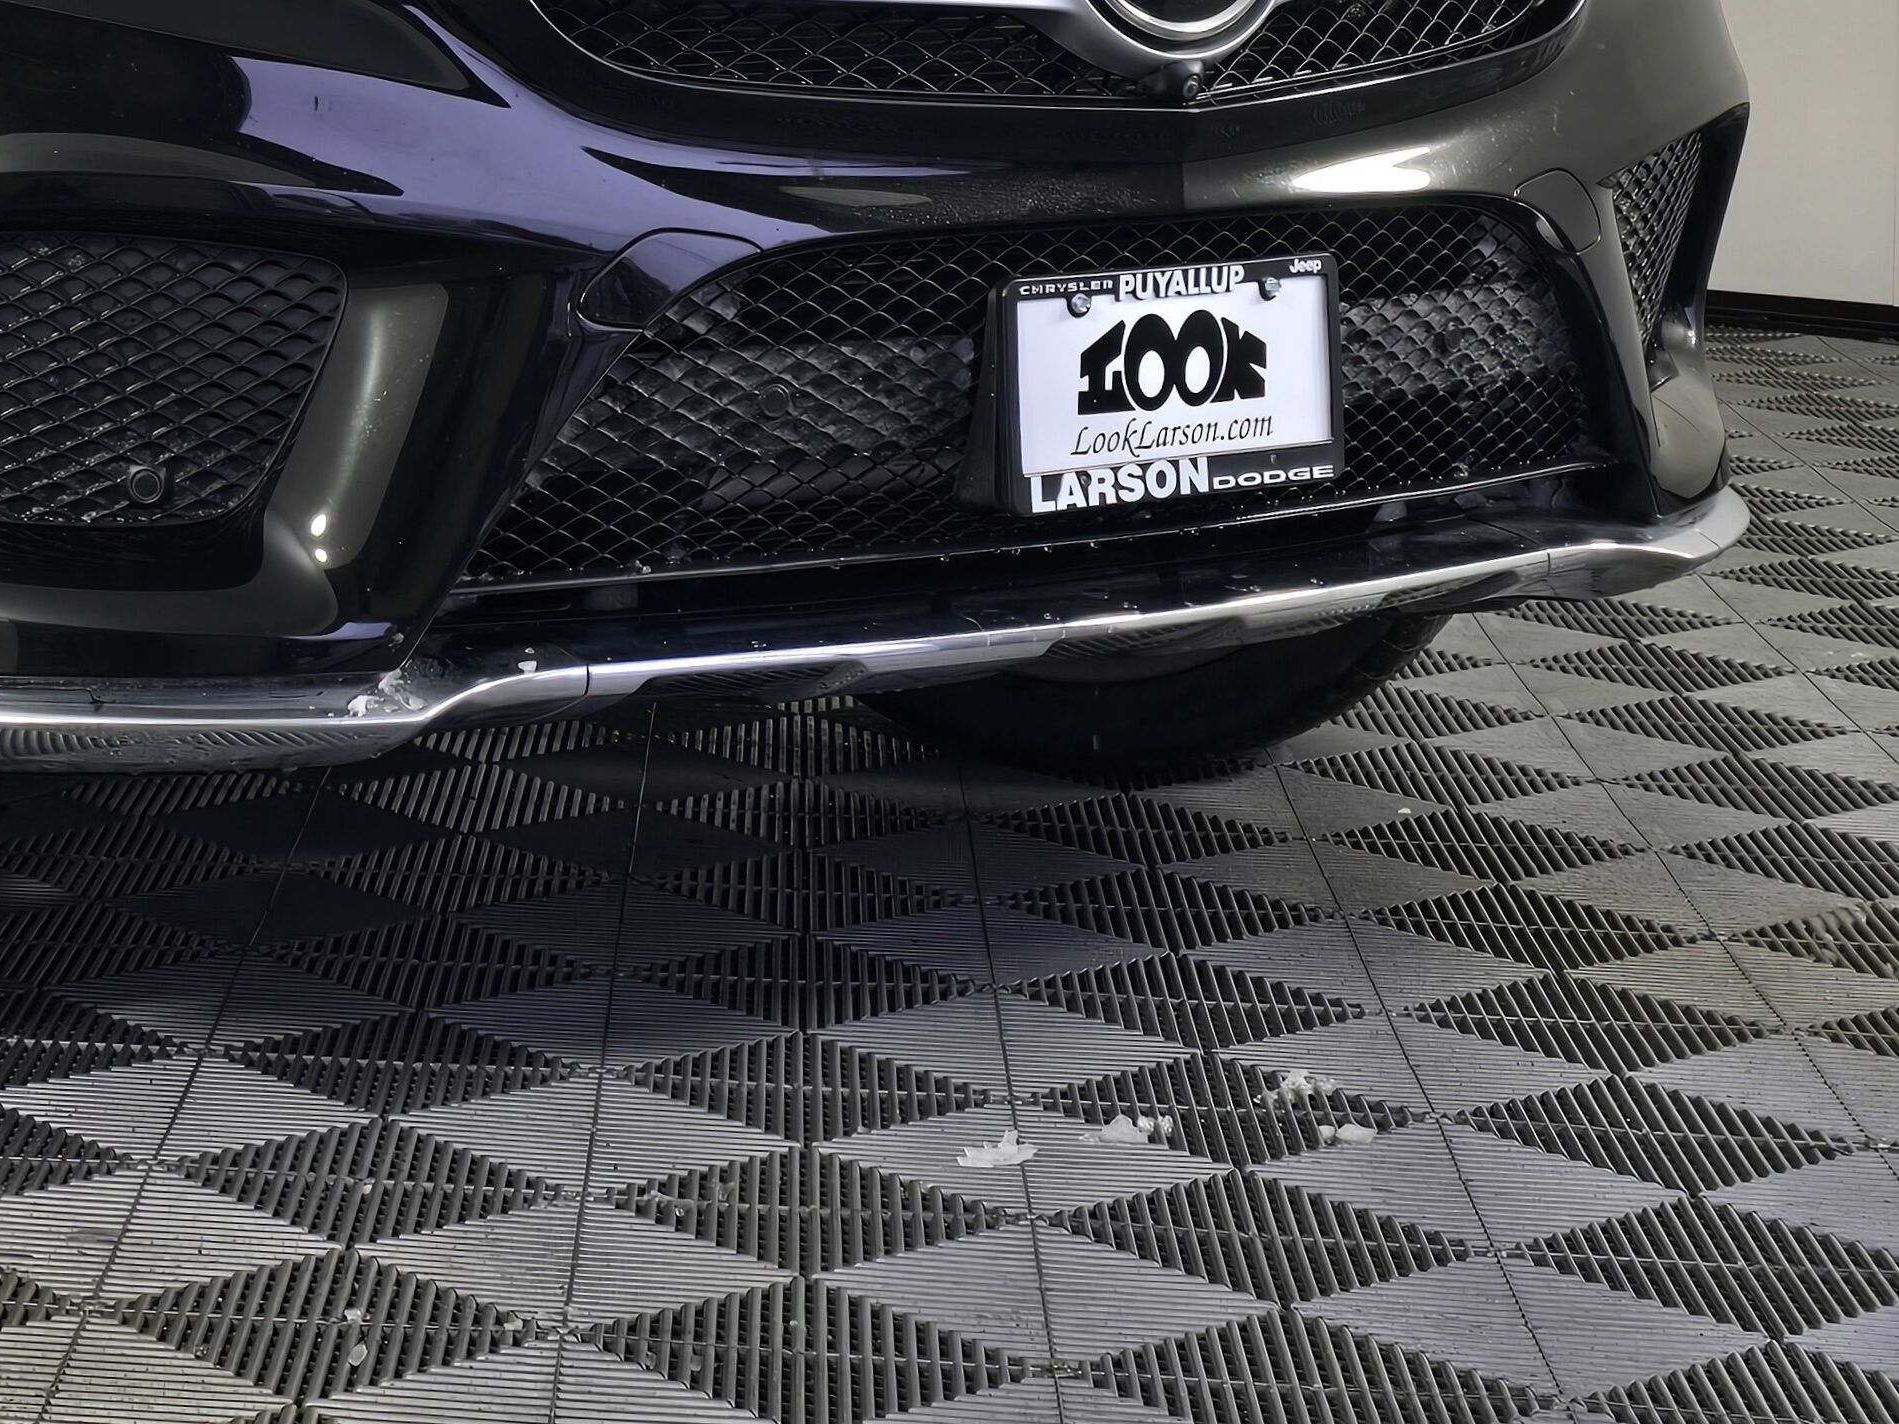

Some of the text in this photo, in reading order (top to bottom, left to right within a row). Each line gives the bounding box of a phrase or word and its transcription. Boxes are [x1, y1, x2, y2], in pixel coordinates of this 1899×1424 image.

[1117, 264, 1246, 302] PUYALLUP
[1289, 258, 1322, 274] Jeep
[1018, 279, 1114, 297] CHRYSLER
[1077, 309, 1268, 415] LOOK
[1069, 413, 1274, 458] LookLarson.com
[1030, 456, 1210, 513] LARSON
[1213, 464, 1335, 490] DODGE
